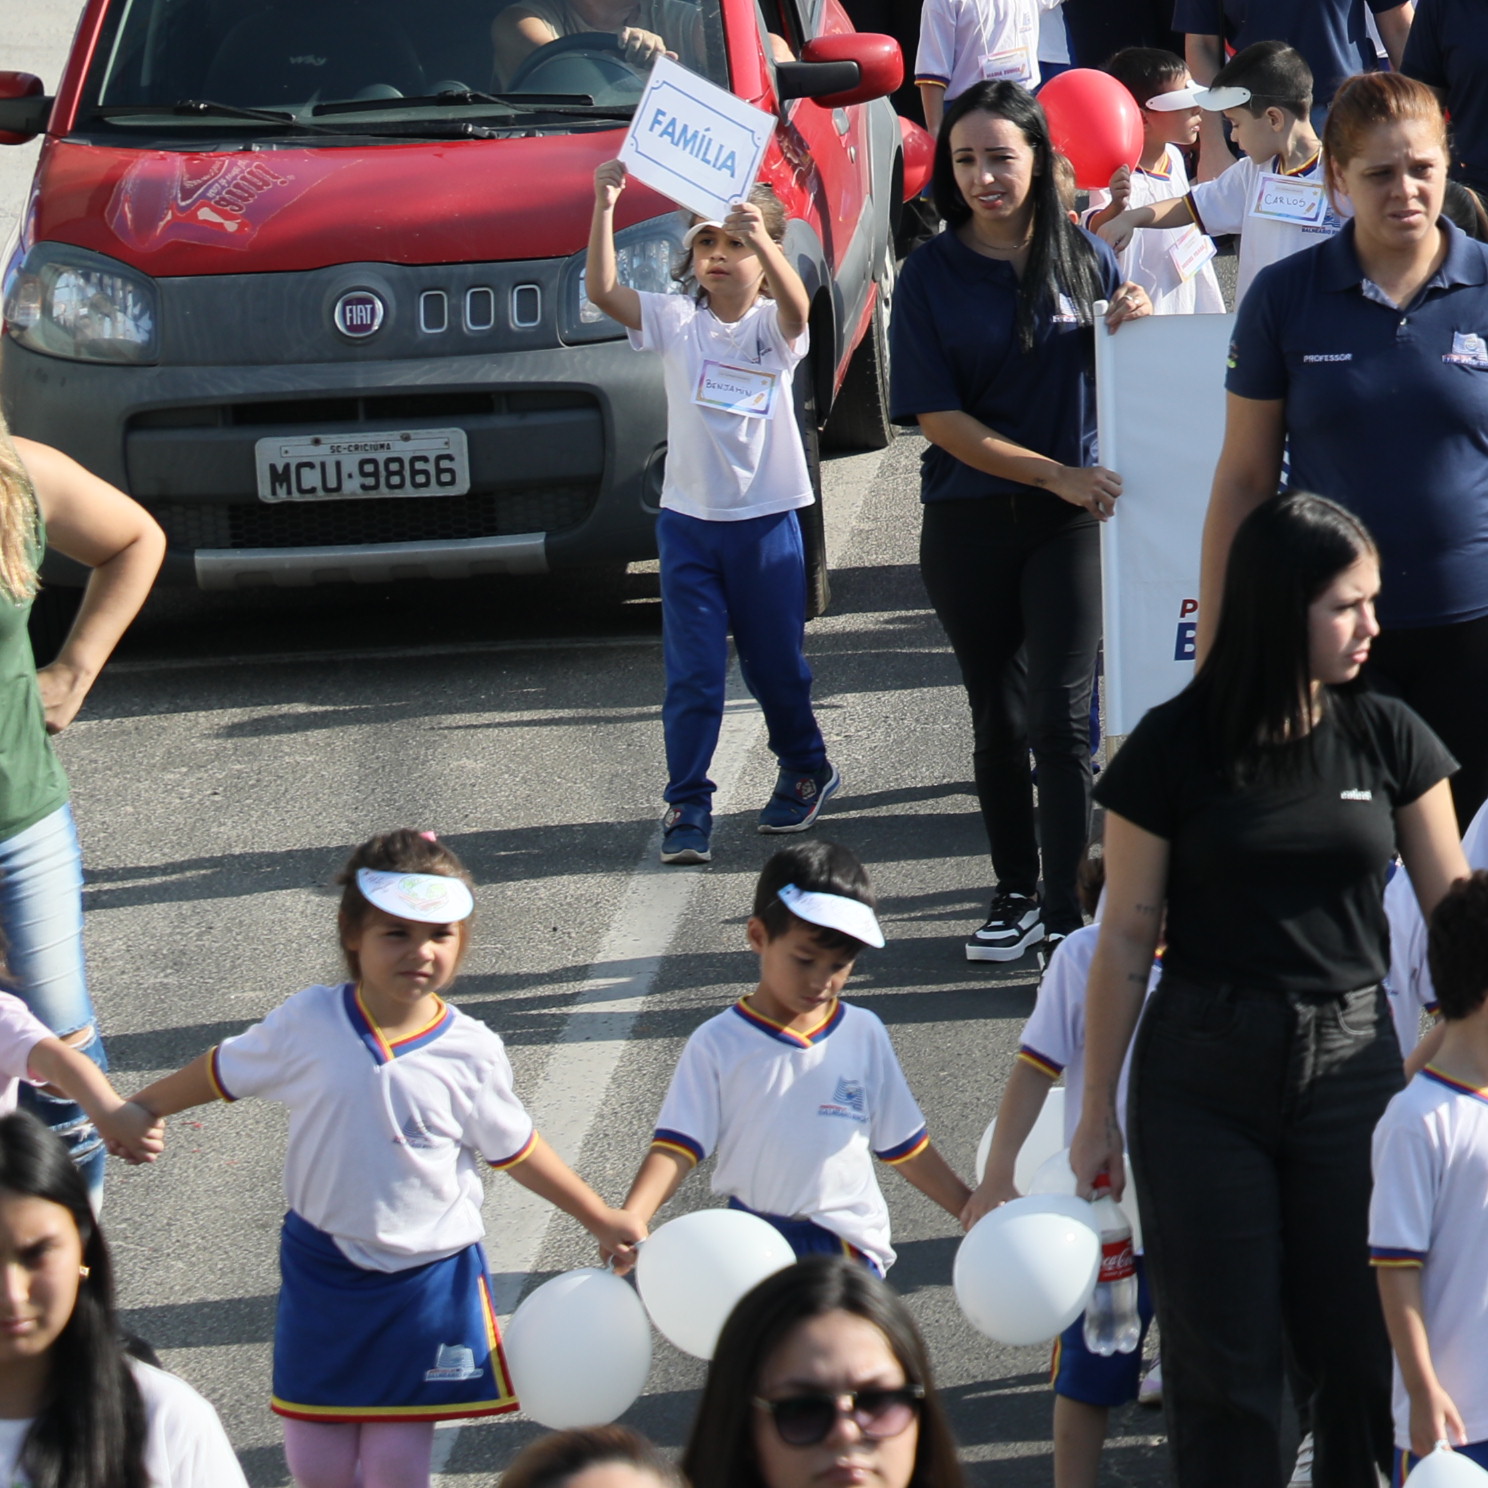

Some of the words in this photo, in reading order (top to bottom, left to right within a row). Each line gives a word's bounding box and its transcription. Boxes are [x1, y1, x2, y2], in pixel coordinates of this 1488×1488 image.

[648, 107, 738, 180] FAMÍLIA
[1264, 193, 1306, 209] CARLOS
[345, 303, 374, 326] FIAT
[1303, 352, 1353, 363] PROFESSOR
[704, 378, 752, 398] BENJAMIN
